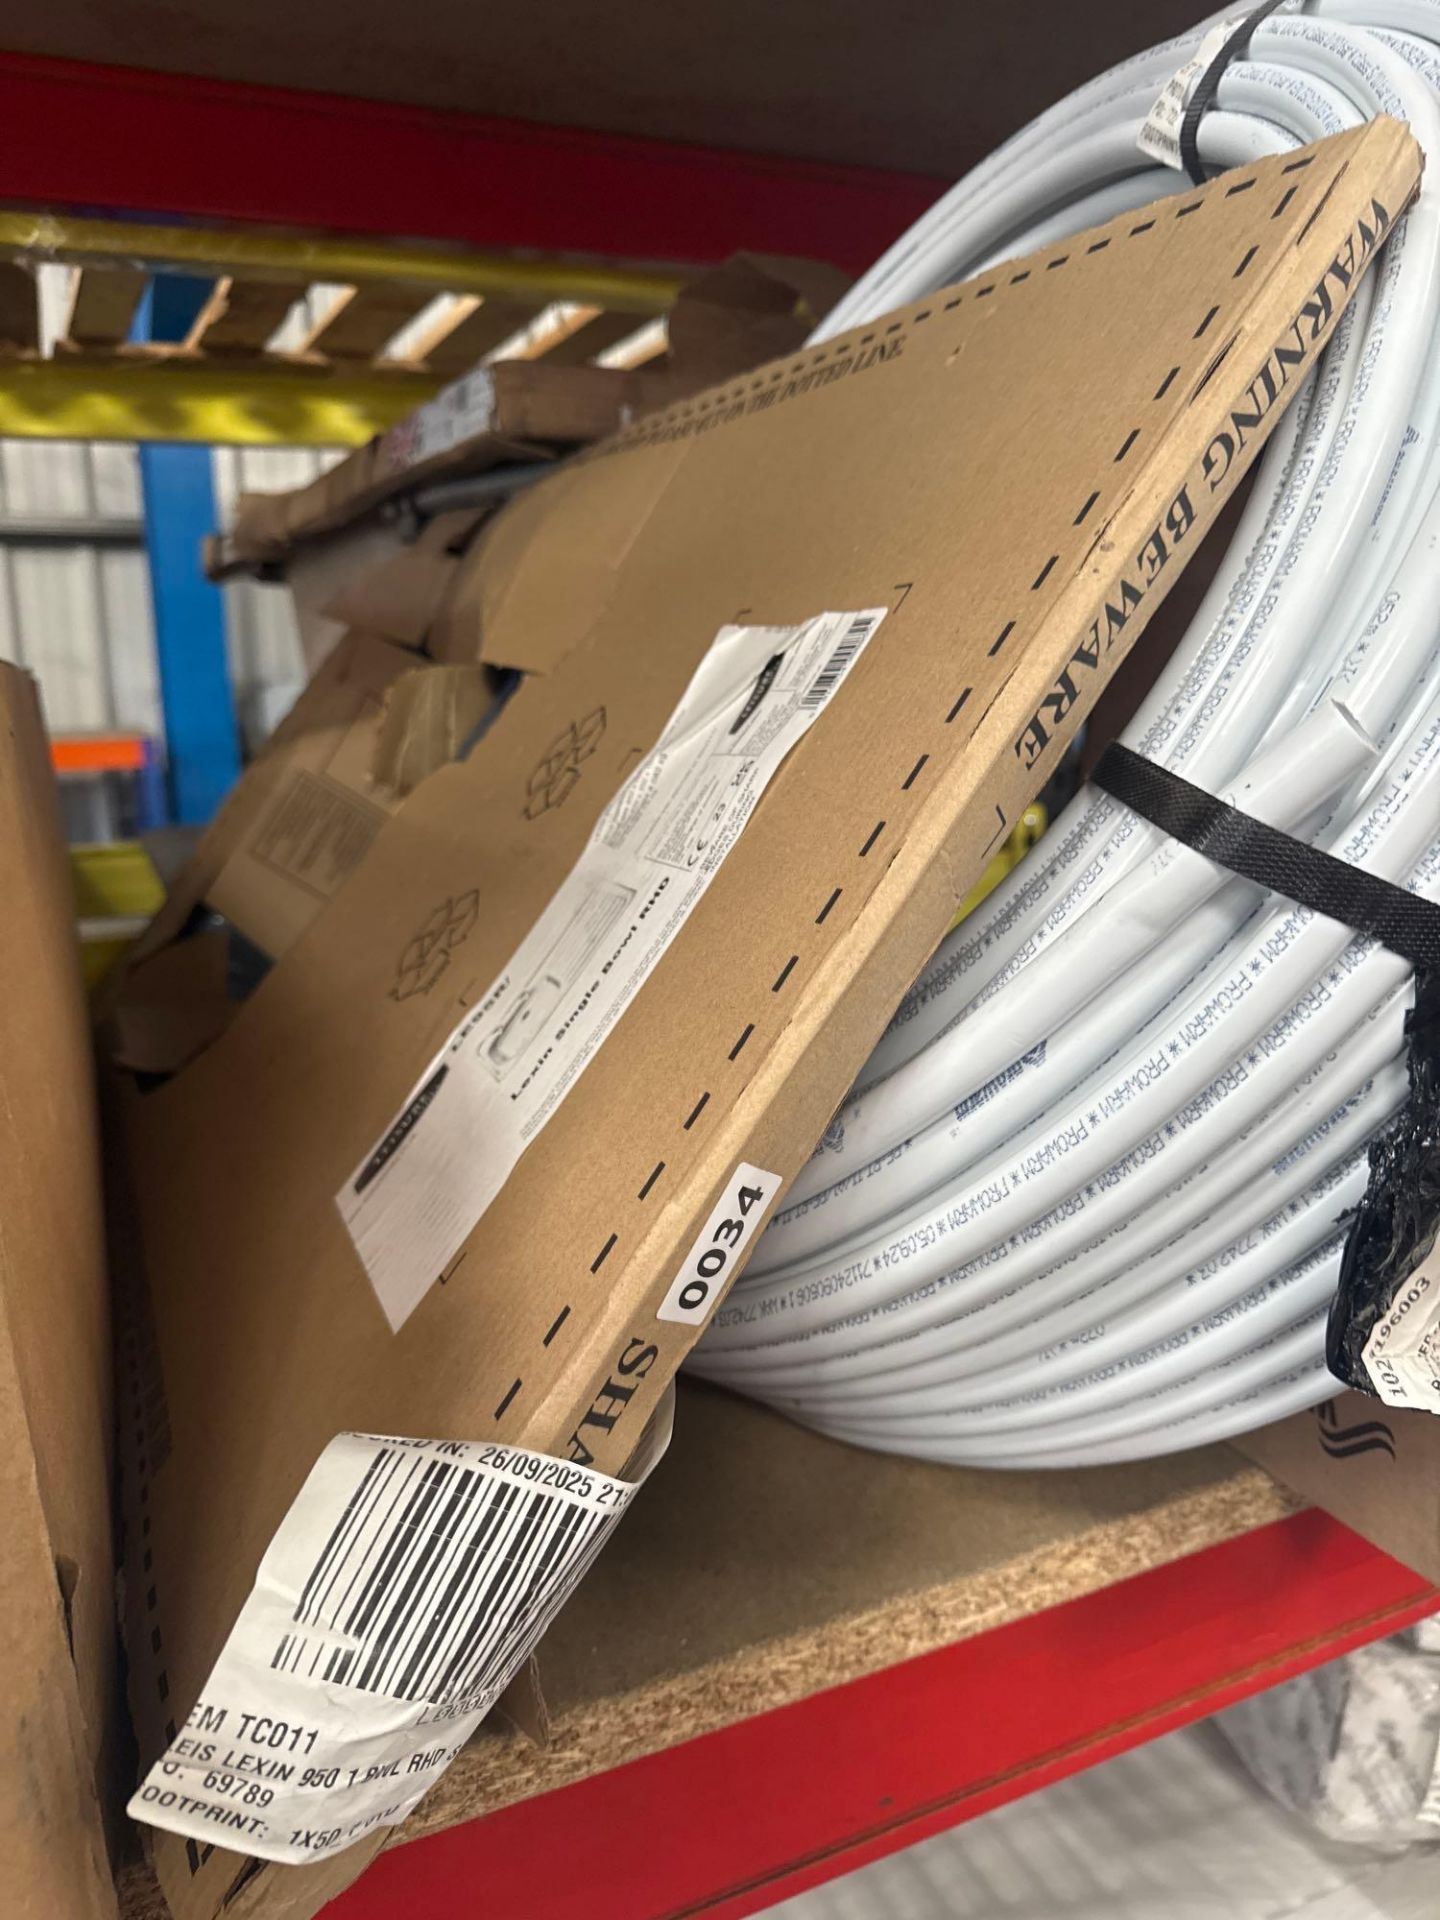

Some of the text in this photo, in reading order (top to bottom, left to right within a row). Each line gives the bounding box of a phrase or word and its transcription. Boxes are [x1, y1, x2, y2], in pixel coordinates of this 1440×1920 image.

[1202, 197, 1390, 493] WARNING
[1232, 540, 1277, 615] PROWARM
[1014, 482, 1199, 772] BEWARE
[1229, 591, 1278, 668] PROWARM
[1180, 628, 1231, 704] PROWARM
[1172, 682, 1228, 761] PROWARM
[1041, 858, 1104, 931] PROWARM
[1257, 902, 1314, 965] OWARM
[511, 1047, 552, 1100] Lexin
[555, 980, 600, 1041] Single
[602, 925, 637, 975] Bowl
[638, 875, 671, 920] RHD
[1177, 970, 1252, 1047] PROWARM
[1255, 980, 1332, 1058] PROWARM
[1097, 1050, 1171, 1119] PROWARM
[1174, 1060, 1250, 1129] PROWARM
[1019, 1118, 1088, 1179] PROWARM
[1094, 1131, 1165, 1192] PROWARM
[944, 1176, 1011, 1230] PROWARM
[1017, 1192, 1085, 1243] PROWARM
[678, 1185, 765, 1310] 0034
[560, 1337, 659, 1465] SHA
[436, 1442, 470, 1458] IN:
[478, 1446, 596, 1498] 26/09/2025
[168, 1738, 213, 1762] EIS
[223, 1752, 297, 1783] LEXIN
[297, 1768, 341, 1789] 950
[407, 1748, 447, 1774] RHD
[236, 1713, 319, 1755] TC011
[141, 1785, 269, 1838] OOTPRINT:
[203, 1770, 275, 1808] 69789
